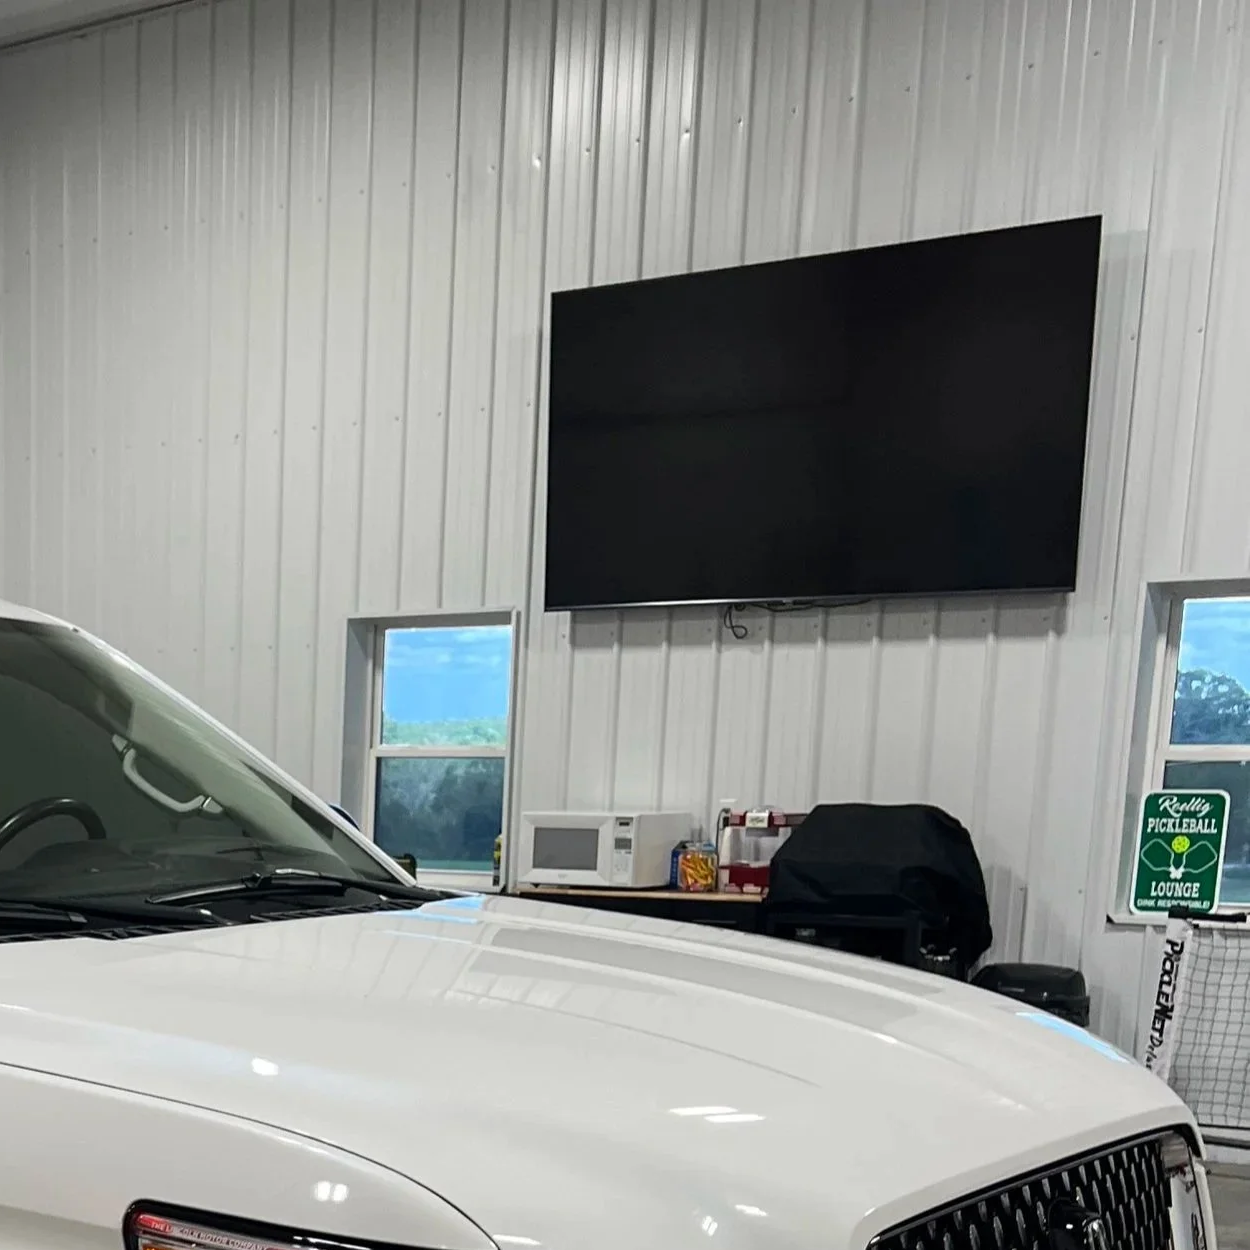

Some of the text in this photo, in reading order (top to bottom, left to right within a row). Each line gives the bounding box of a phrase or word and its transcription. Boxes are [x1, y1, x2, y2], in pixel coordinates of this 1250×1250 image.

[1147, 817, 1218, 833] PICKLEBALL
[1150, 881, 1200, 898] LOUNGE
[201, 1230, 228, 1245] MOTOR
